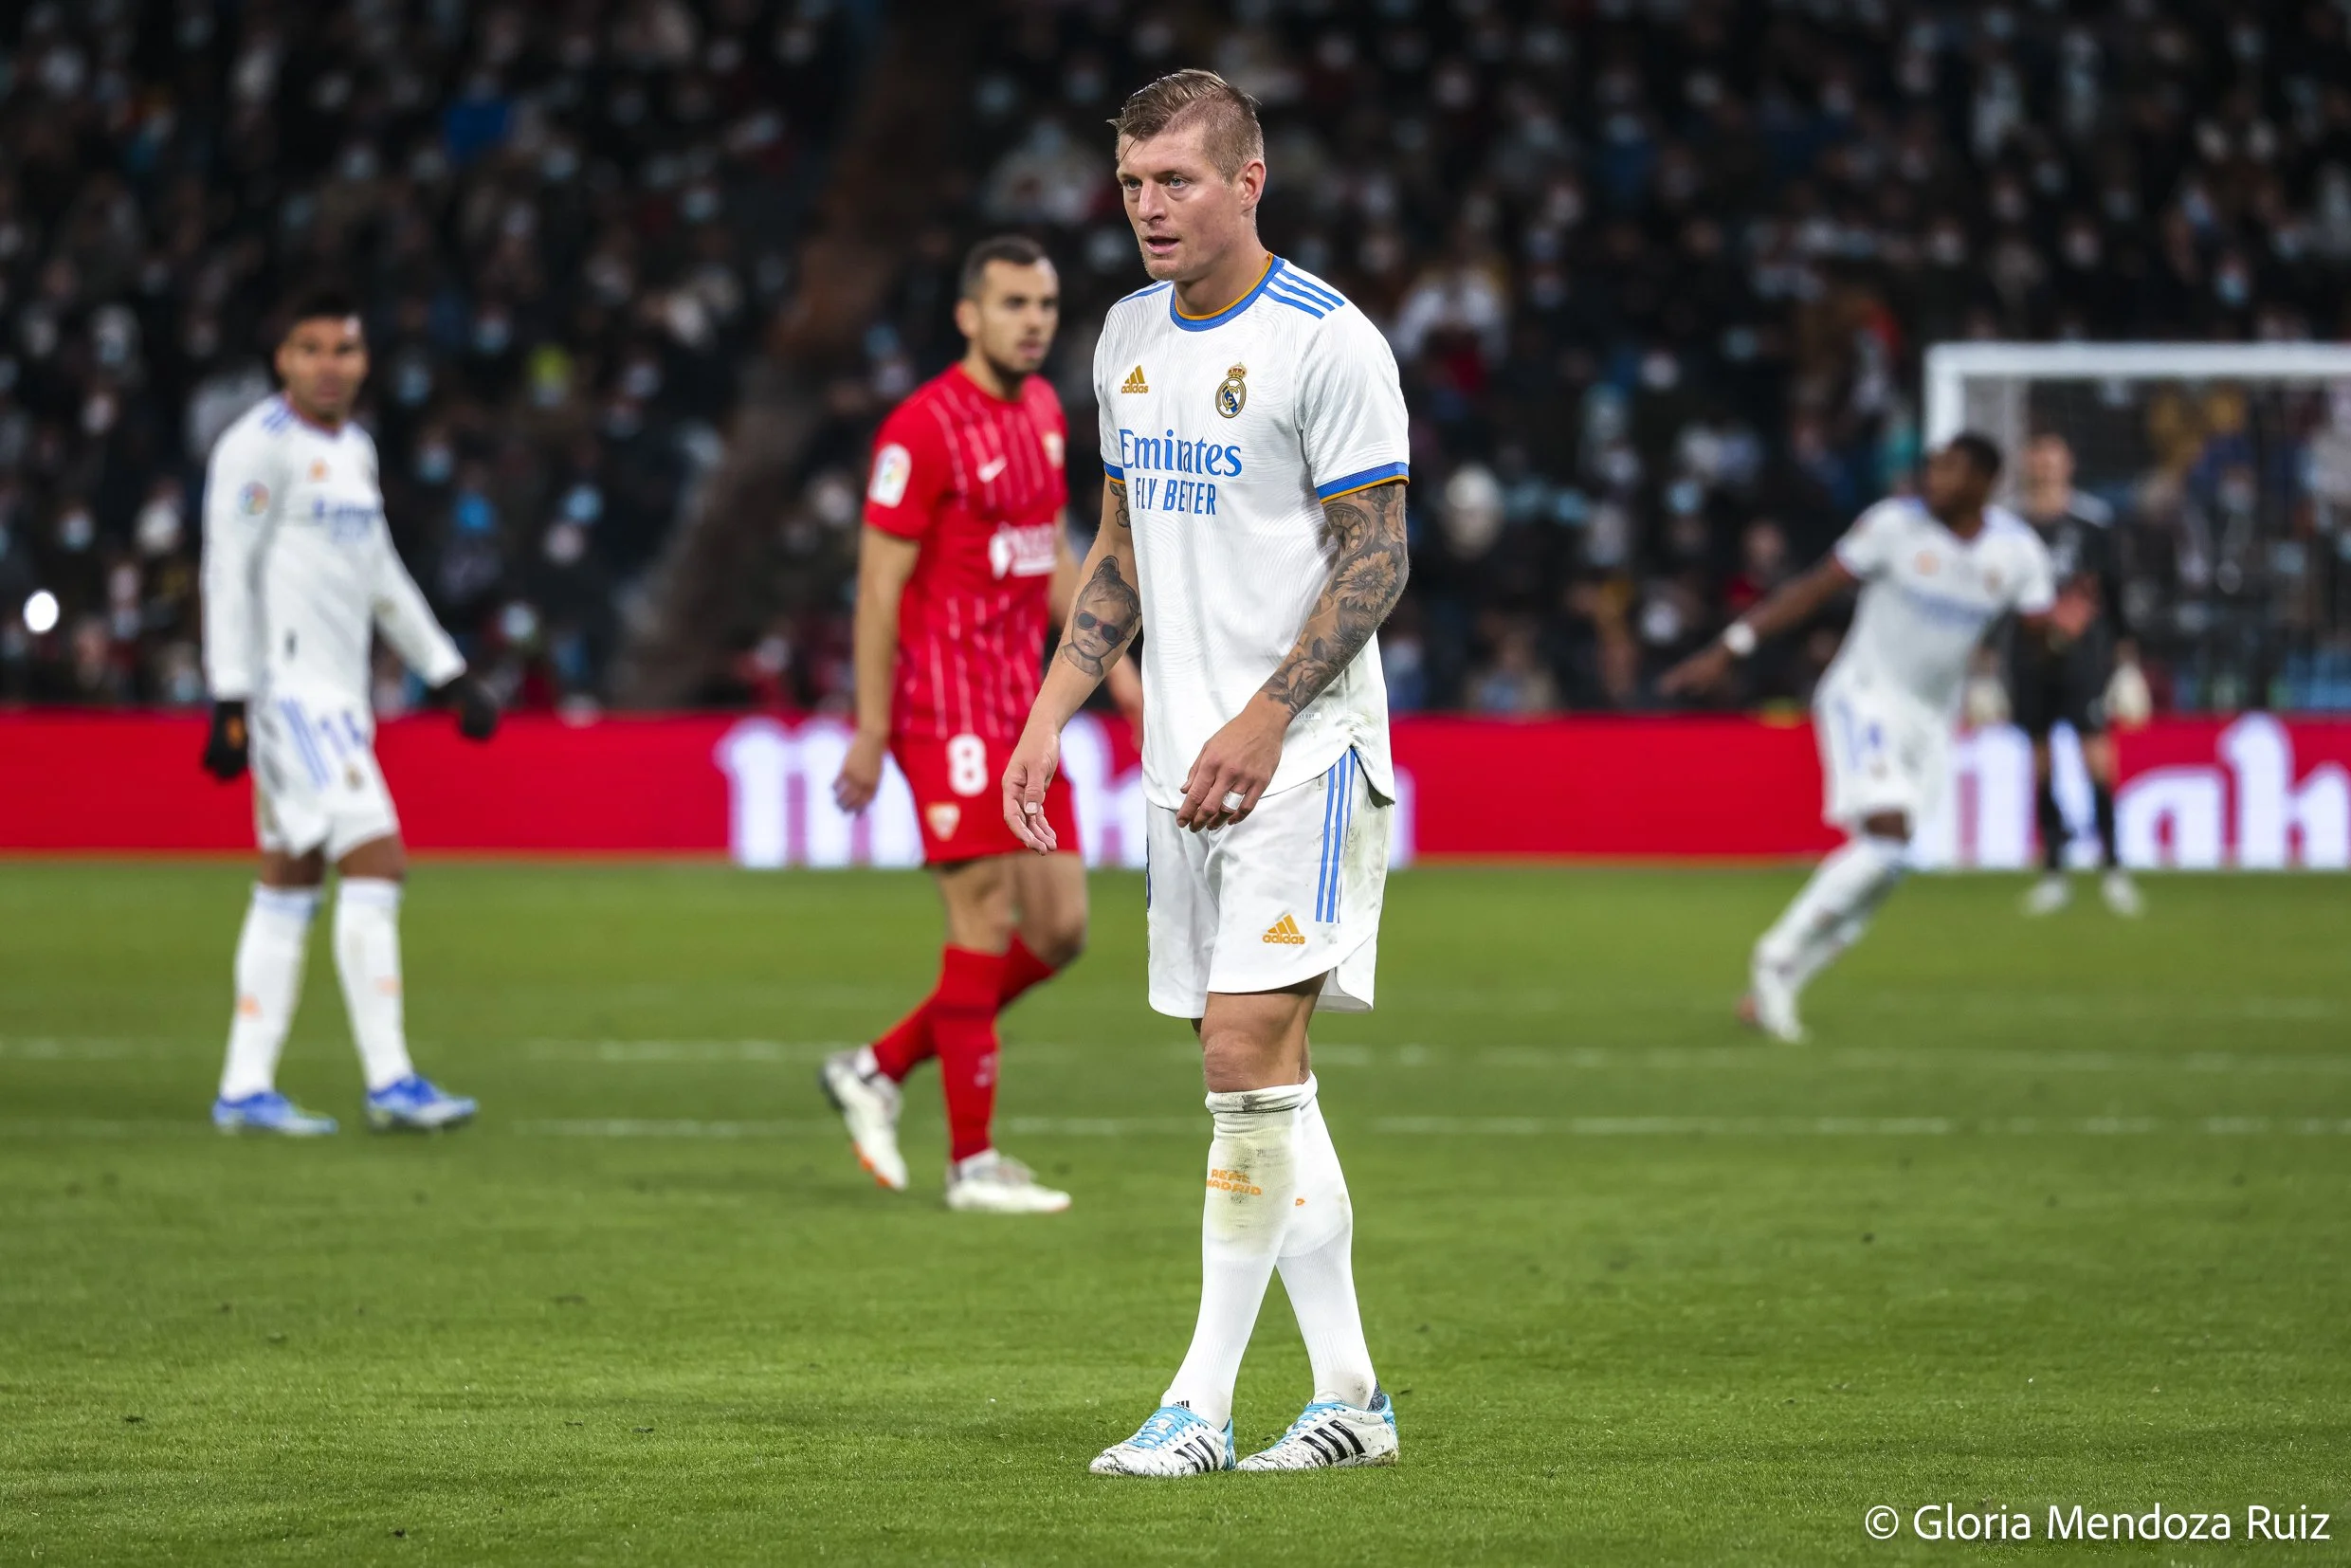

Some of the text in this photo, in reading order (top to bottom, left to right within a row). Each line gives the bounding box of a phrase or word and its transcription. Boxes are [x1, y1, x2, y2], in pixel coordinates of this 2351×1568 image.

[1121, 382, 1149, 394] adidas
[1119, 428, 1243, 477] Emirates
[1136, 477, 1158, 510] FLY
[946, 734, 989, 797] 8
[1262, 933, 1305, 944] adidas
